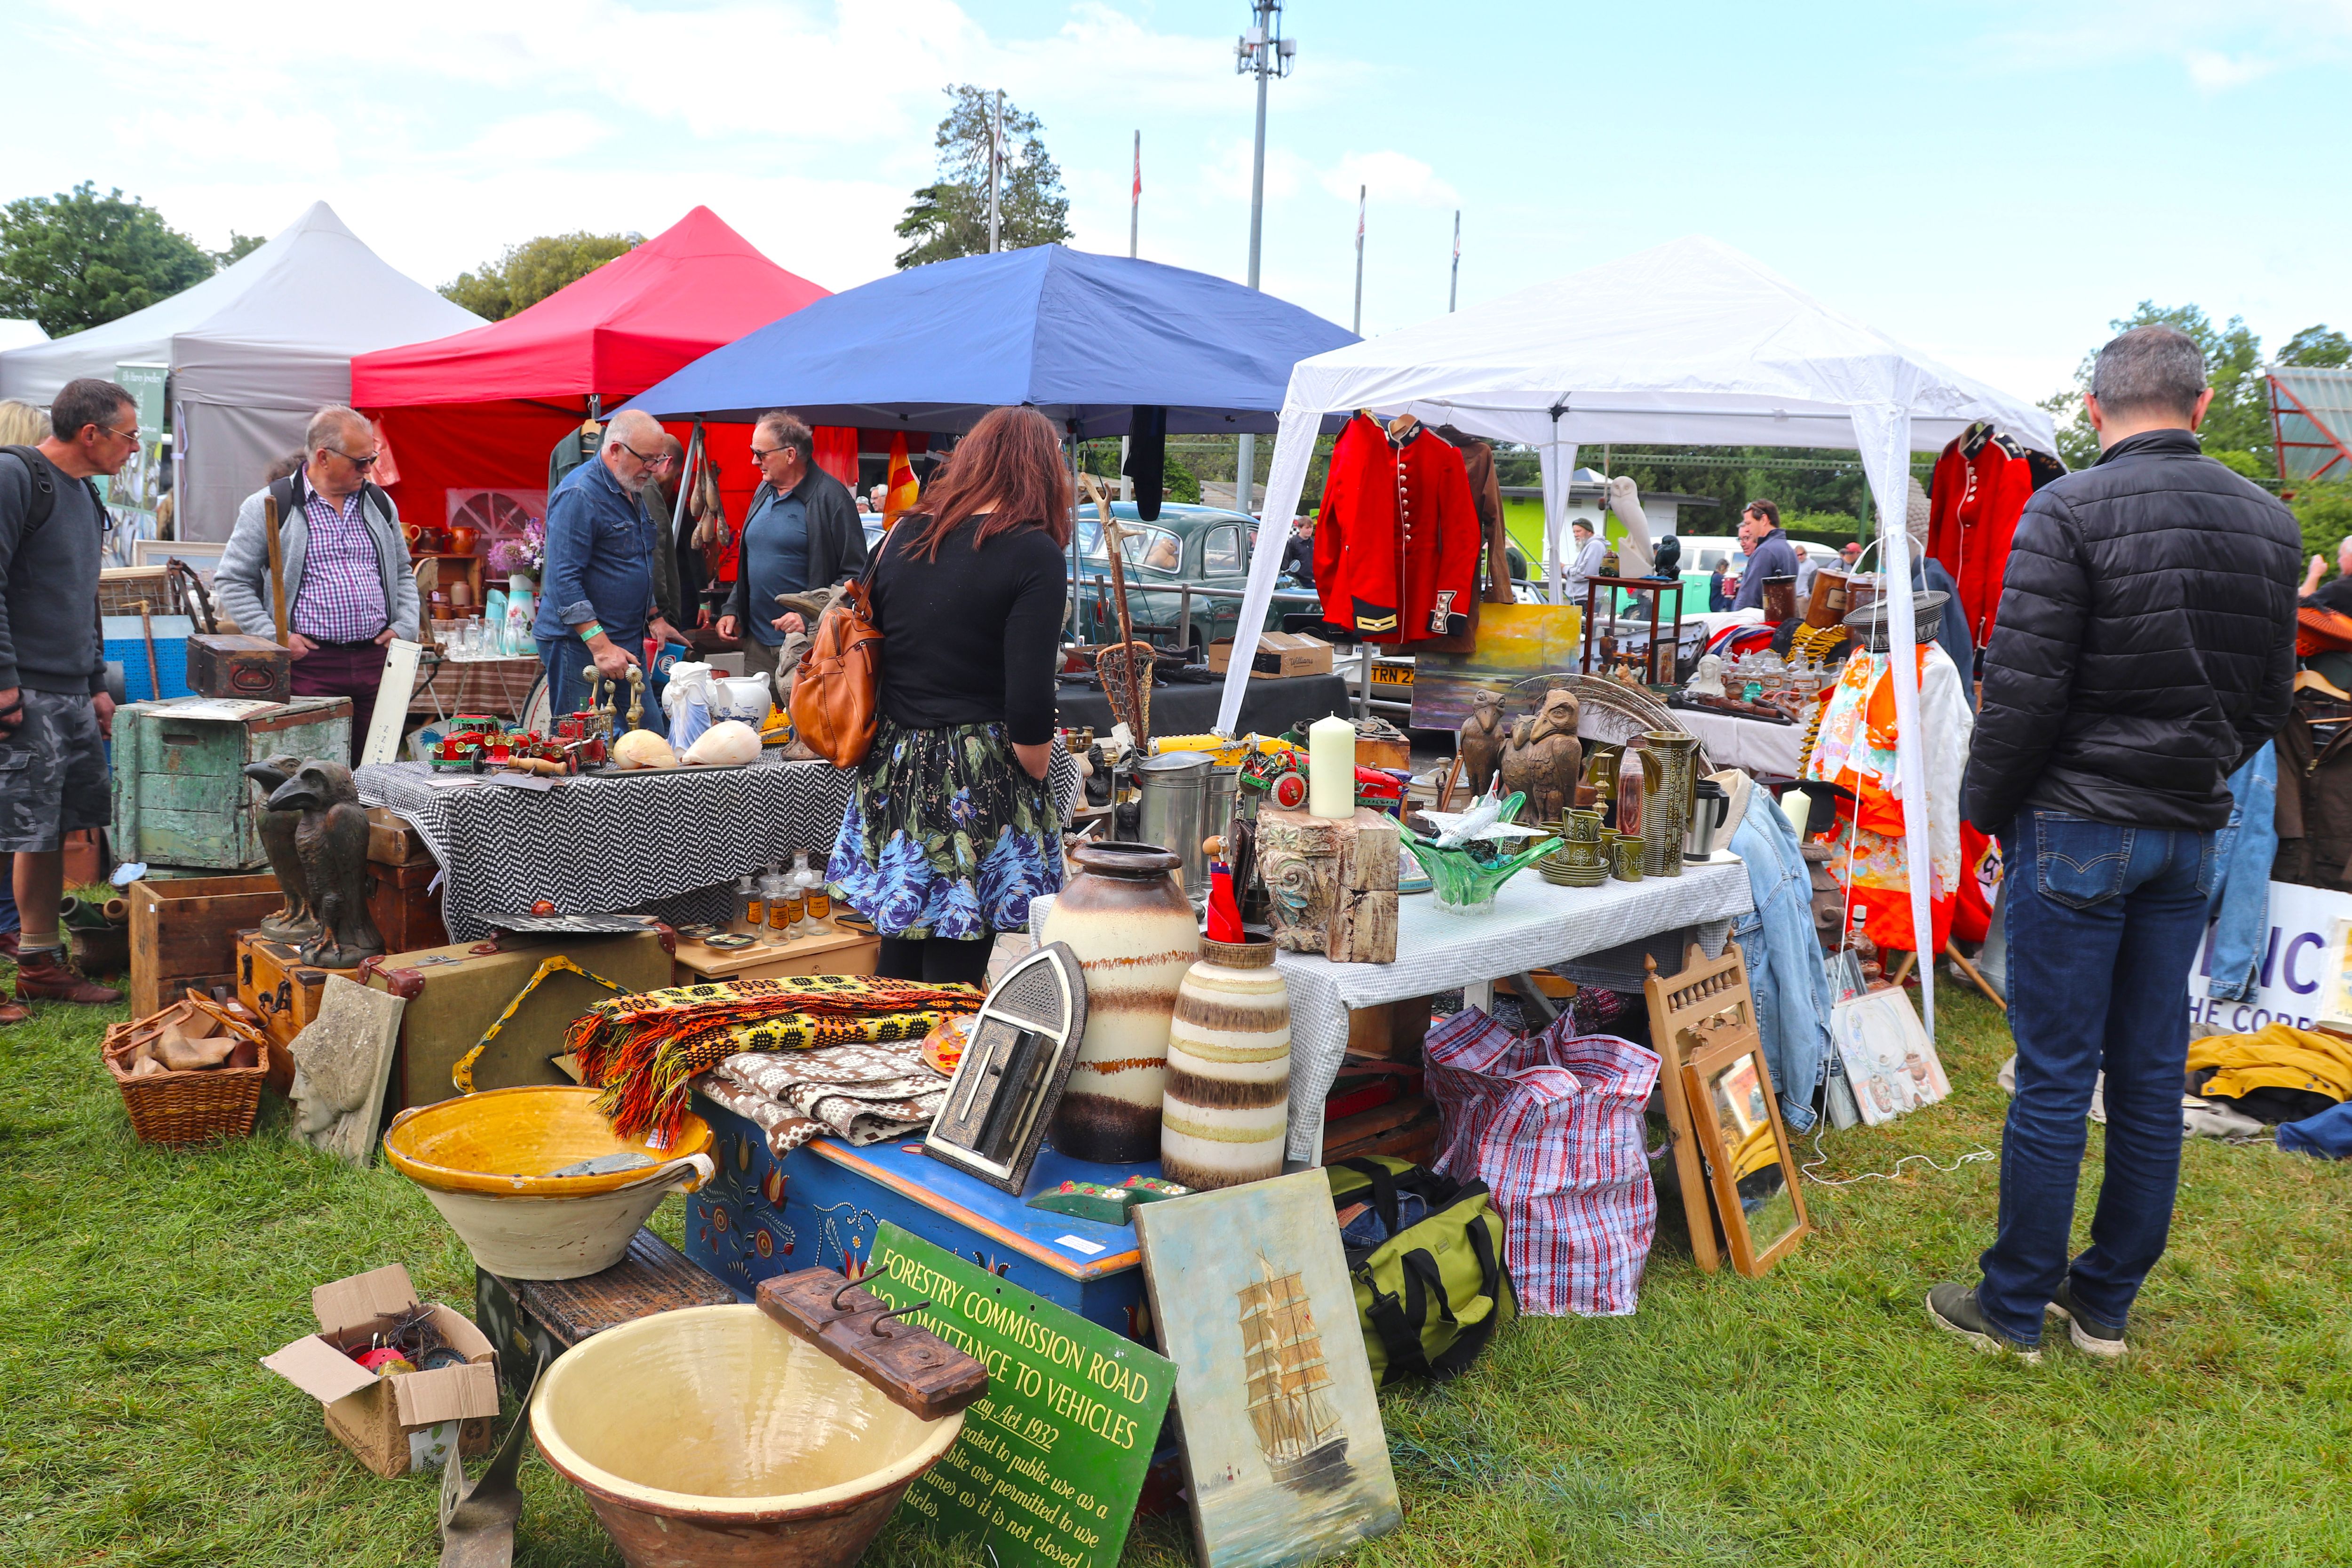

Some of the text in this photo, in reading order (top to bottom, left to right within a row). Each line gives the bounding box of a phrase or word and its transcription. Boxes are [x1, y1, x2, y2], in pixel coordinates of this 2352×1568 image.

[663, 658, 672, 671] FINA
[1289, 657, 1313, 665] Williams
[1372, 668, 1398, 682] TRN
[2190, 996, 2223, 1026] HE
[882, 1248, 1149, 1404] FORESTRY COMMISSION ROAD
[896, 1301, 1012, 1383] ADMITTANCE
[1014, 1361, 1042, 1398] TO
[1047, 1377, 1138, 1450] VEHICLES
[972, 1392, 1060, 1449] ay Act 1932
[943, 1443, 1100, 1549] blic are permitted to use
[960, 1420, 1109, 1520] icated to public use as a
[902, 1481, 940, 1522] hicles.
[922, 1467, 957, 1496] times
[959, 1490, 977, 1508] as
[977, 1497, 993, 1517] it
[991, 1506, 1005, 1526] is
[1006, 1520, 1035, 1543] not
